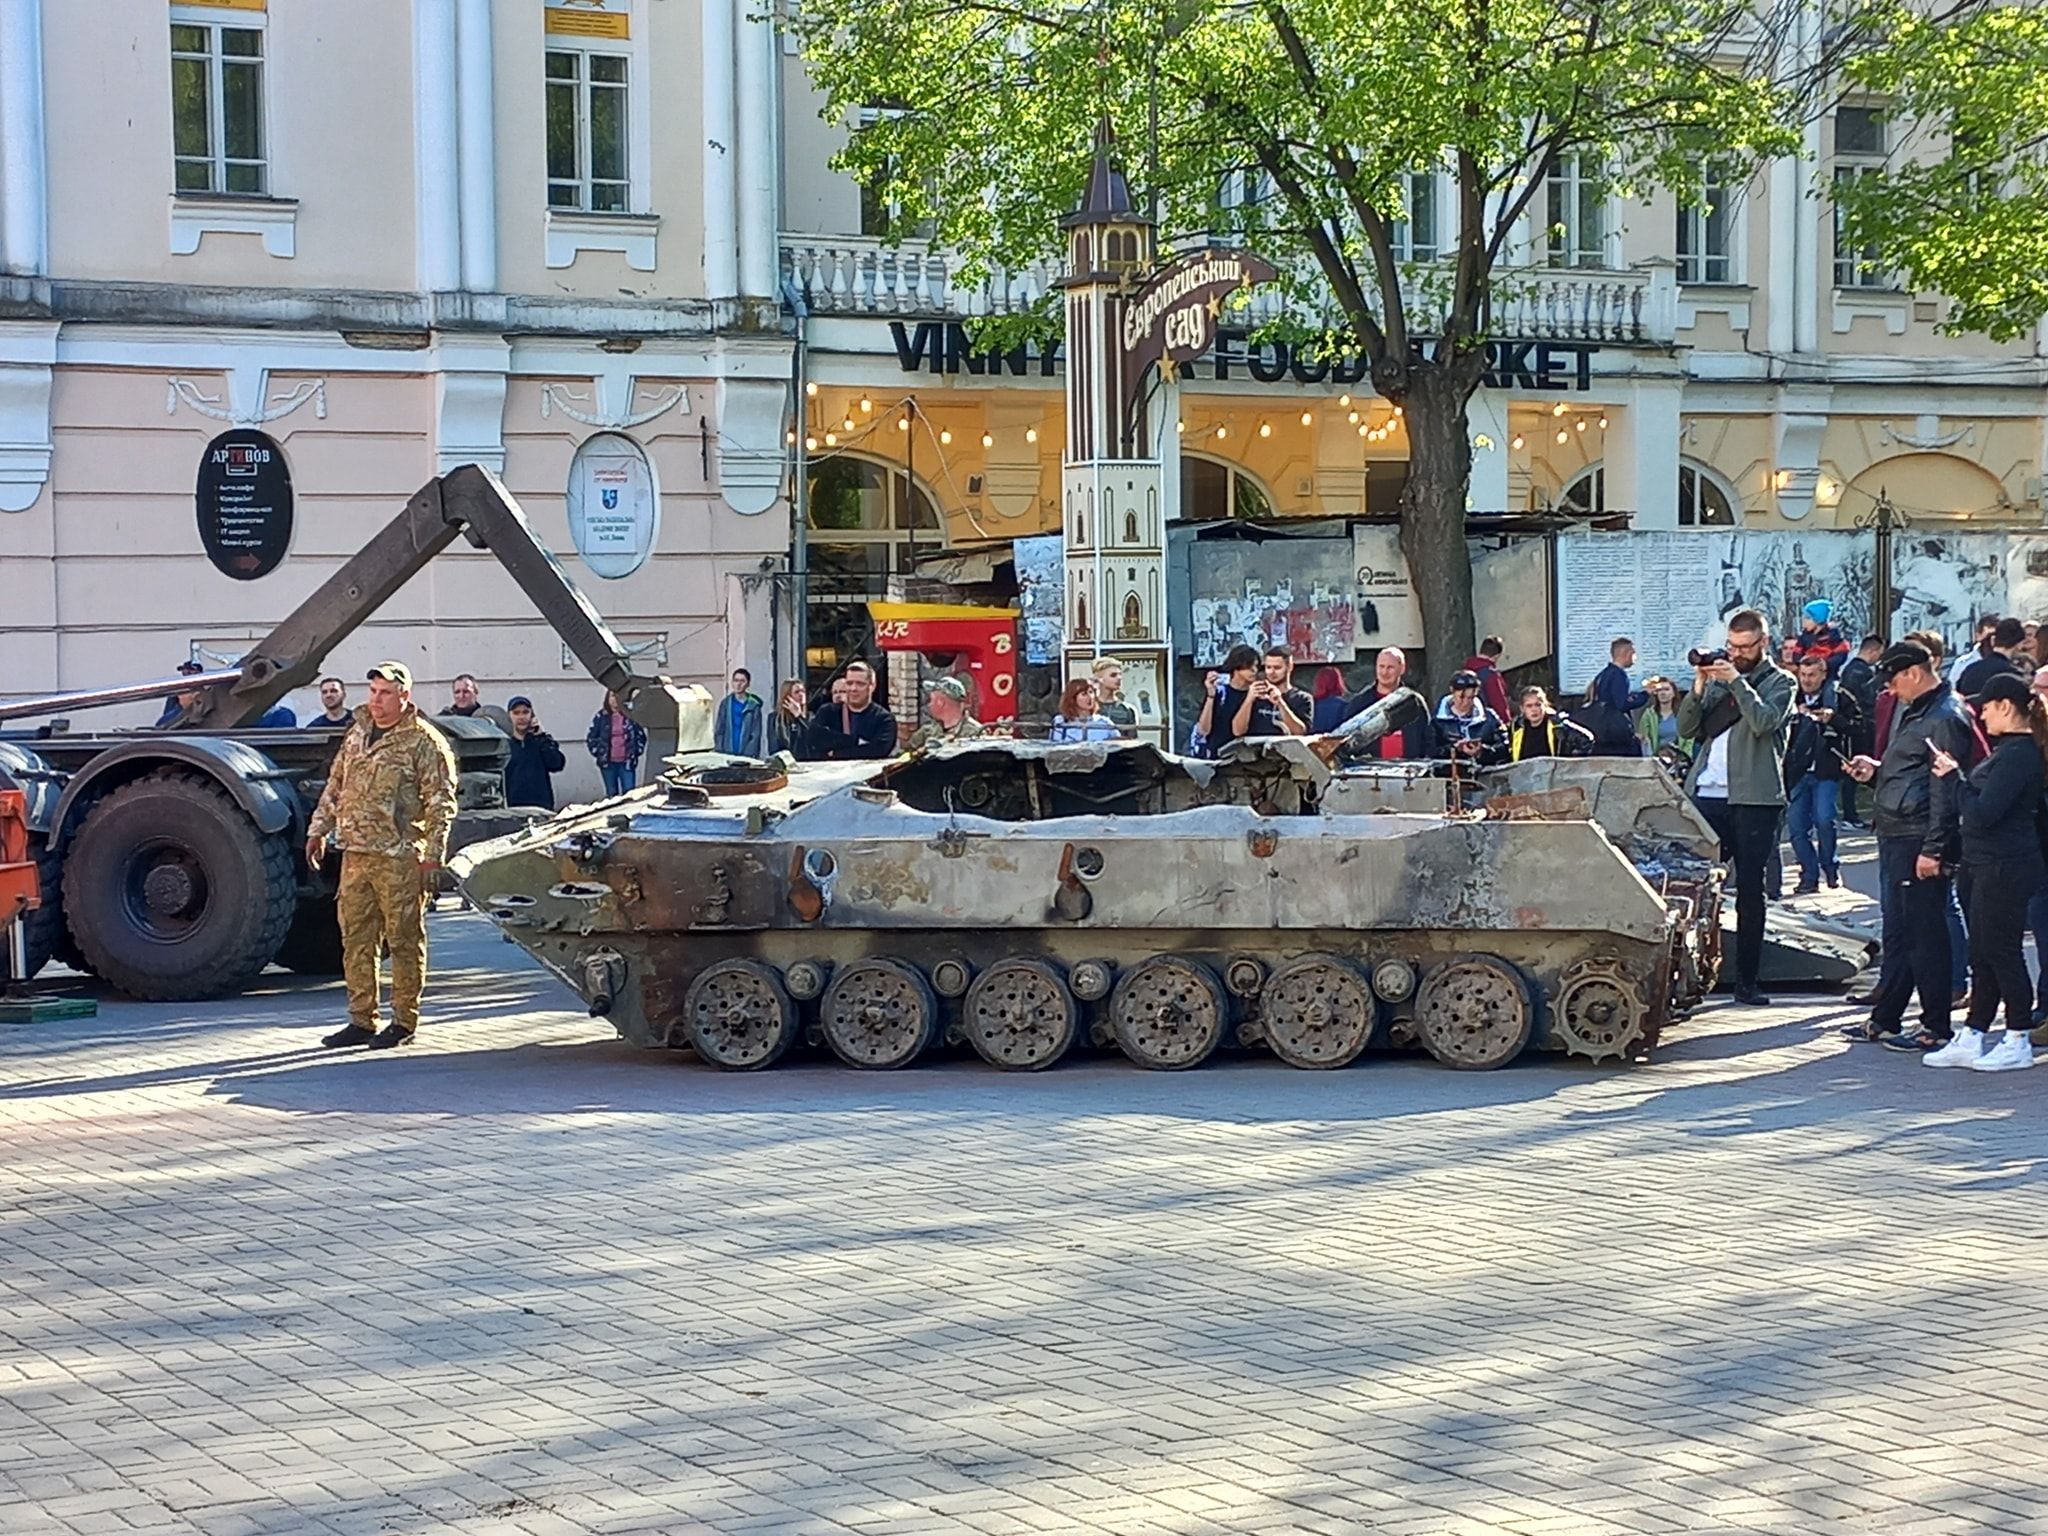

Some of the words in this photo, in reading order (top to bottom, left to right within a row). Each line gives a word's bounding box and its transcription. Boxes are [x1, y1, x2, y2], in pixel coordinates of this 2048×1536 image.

[1123, 253, 1240, 351] Європейський
[1165, 303, 1206, 350] сад
[1215, 328, 1367, 384] FOOD
